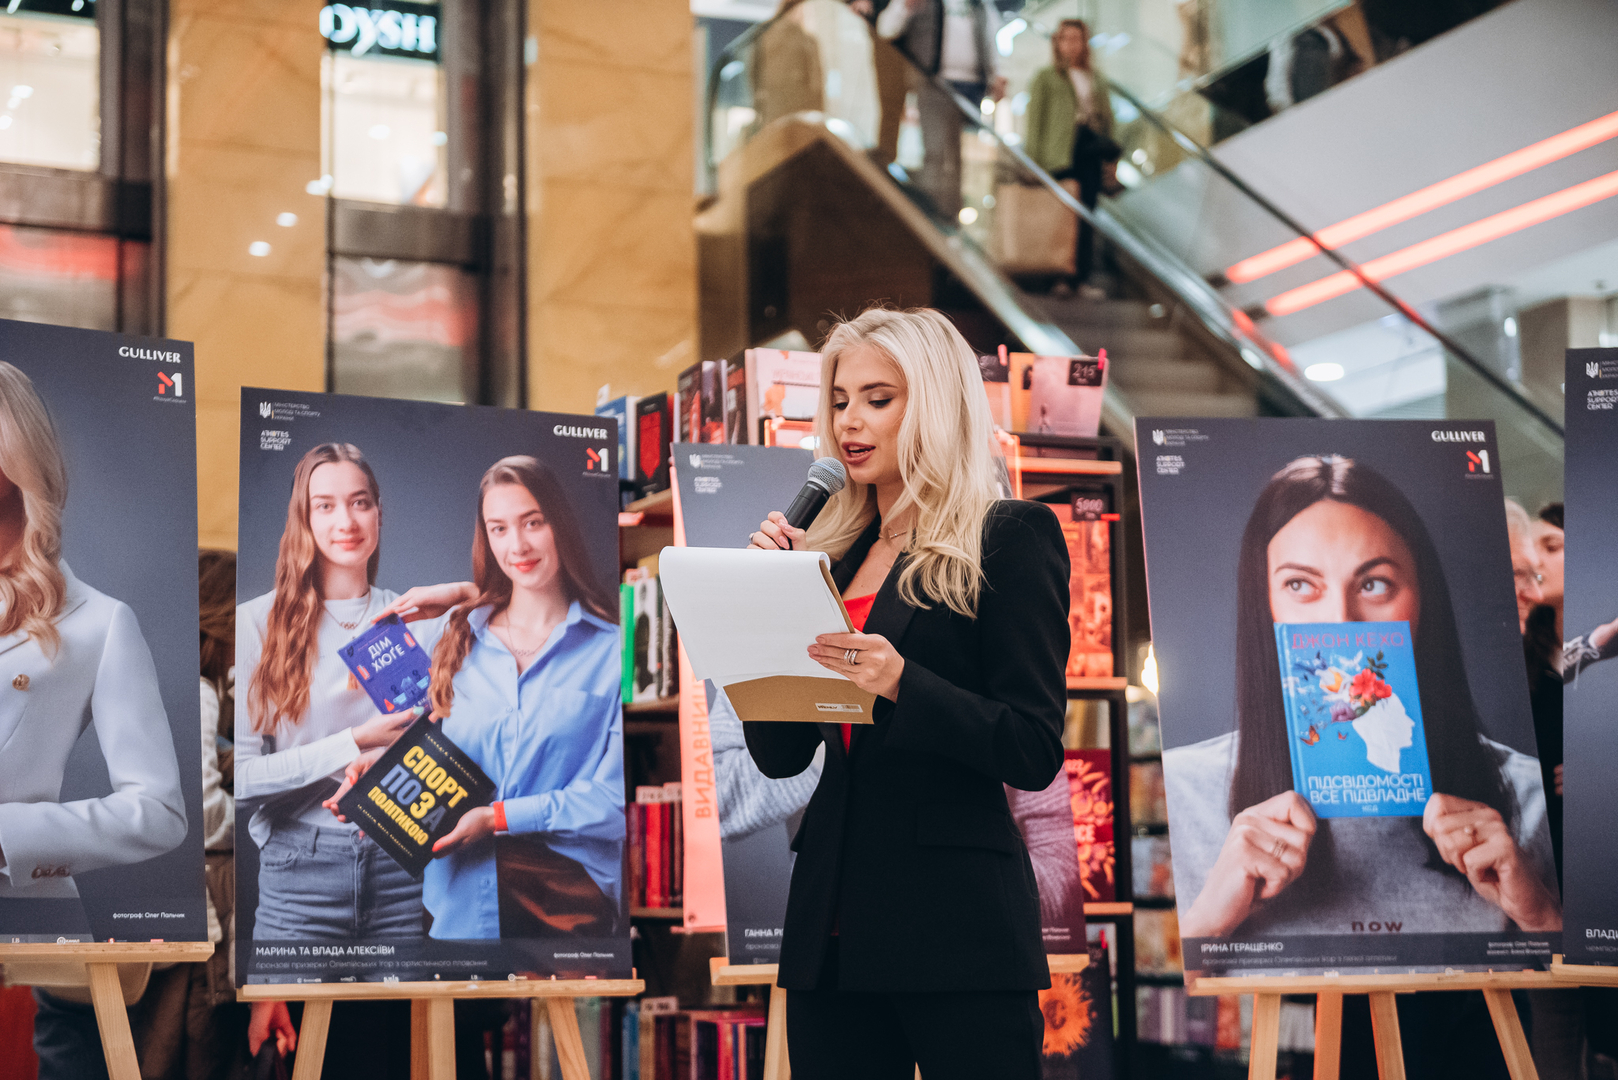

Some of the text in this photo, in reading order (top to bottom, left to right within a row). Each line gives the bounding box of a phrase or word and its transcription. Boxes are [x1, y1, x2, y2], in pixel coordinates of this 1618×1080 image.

[118, 346, 181, 364] GULLIVER
[553, 424, 608, 440] GULLIVER
[1431, 430, 1486, 443] GULLIVER
[368, 636, 392, 660] ДІМ
[1292, 632, 1404, 649] ДЖОН КЕХО
[403, 745, 469, 808] СПОРТ
[1308, 774, 1424, 790] ПІДСВІДОМОСТІ
[380, 763, 447, 832] ПОЗА
[1310, 788, 1426, 804] ВСЕ ПІДВЛАДНЕ
[367, 786, 429, 846] ПОЛІТИКОЮ
[745, 928, 773, 937] ГАННА
[1352, 921, 1403, 932] now
[256, 945, 395, 956] МАРИНА ТА ВЛАДА АЛЕКСІЇВИ
[1201, 942, 1284, 953] ІРИНА ГЕРАЩЕНКО
